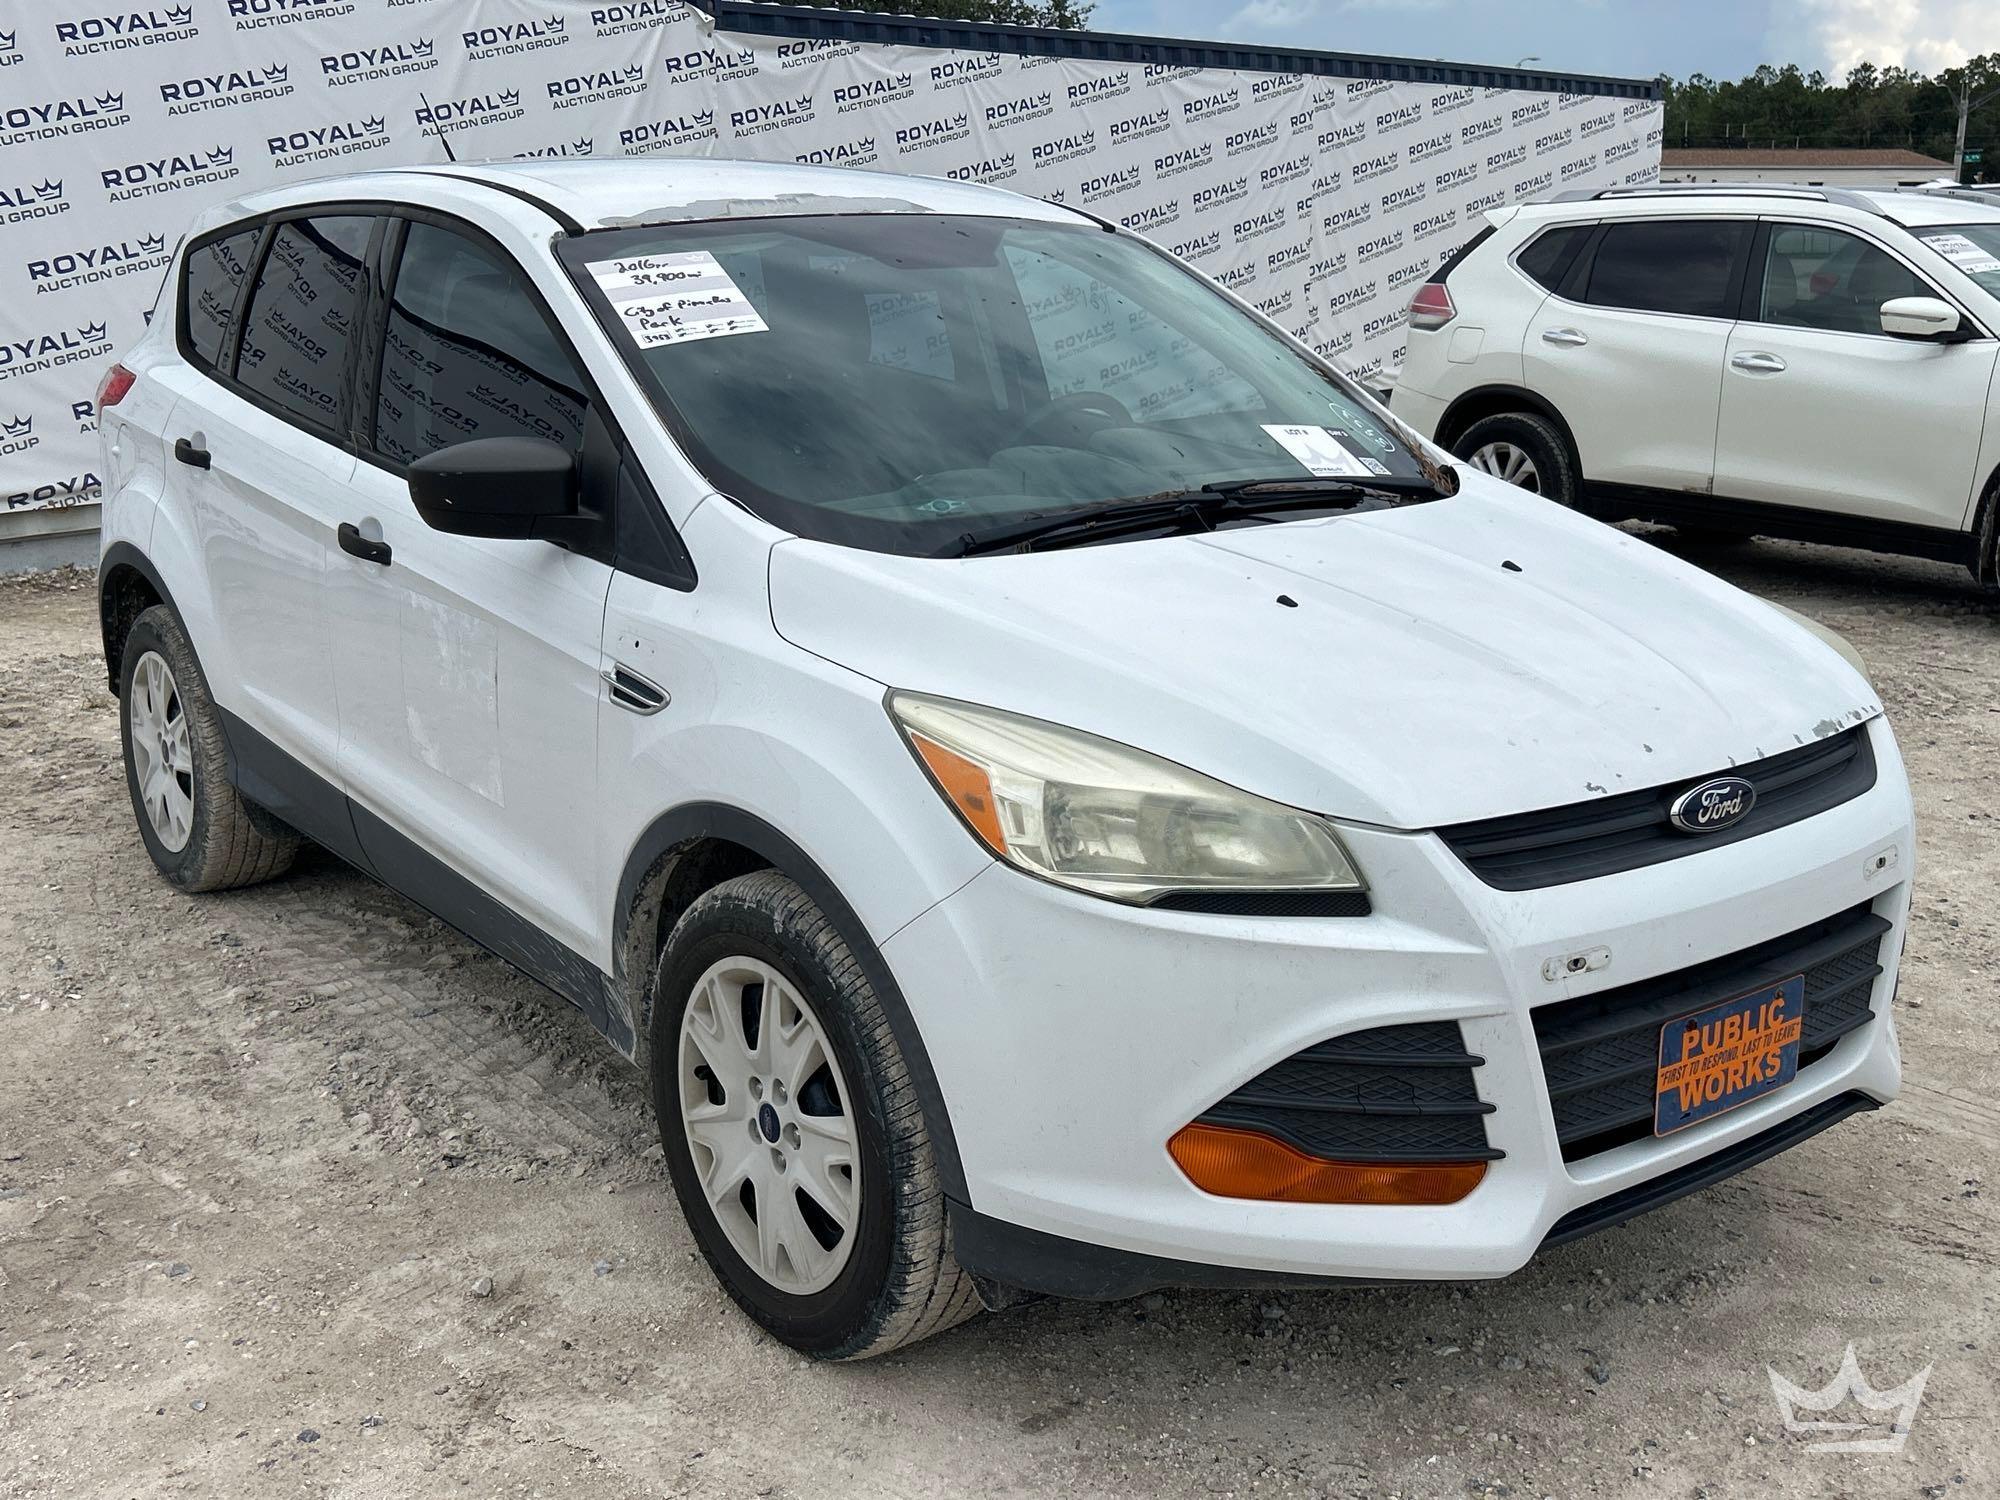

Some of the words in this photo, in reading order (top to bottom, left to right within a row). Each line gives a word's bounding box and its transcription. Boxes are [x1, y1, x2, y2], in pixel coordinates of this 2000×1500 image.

[236, 12, 303, 31] AUCTION
[305, 5, 355, 20] GROUP
[591, 0, 666, 26] ROYAL
[56, 12, 168, 42] ROYAL
[462, 21, 545, 49] ROYAL
[596, 21, 648, 38] AUCTION
[649, 12, 691, 28] GROUP
[65, 37, 140, 57] AUCTION
[143, 28, 199, 45] GROUP
[468, 45, 524, 61] AUCTION
[527, 36, 569, 51] GROUP
[321, 46, 413, 73] ROYAL
[781, 54, 825, 70] AUCTION
[827, 46, 860, 60] GROUP
[931, 58, 986, 81] ROYAL
[328, 68, 390, 87] AUCTION
[392, 59, 439, 75] GROUP
[547, 70, 624, 98] ROYAL
[723, 67, 759, 82] GROUP
[934, 77, 972, 91] AUCTION
[973, 68, 1002, 82] GROUP
[1252, 75, 1292, 94] ROYAL
[160, 70, 265, 102] ROYAL
[552, 92, 605, 110] AUCTION
[607, 83, 648, 100] GROUP
[834, 78, 897, 103] ROYAL
[1068, 76, 1117, 99] ROYAL
[168, 95, 238, 116] AUCTION
[242, 85, 294, 102] GROUP
[415, 95, 500, 125] ROYAL
[837, 97, 880, 114] AUCTION
[881, 90, 914, 104] GROUP
[986, 98, 1038, 121] ROYAL
[1184, 93, 1228, 115] ROYAL
[1432, 91, 1465, 108] ROYAL
[1623, 102, 1649, 117] ROYAL
[421, 118, 479, 138] AUCTION
[480, 109, 524, 125] GROUP
[731, 100, 797, 127] ROYAL
[988, 116, 1024, 131] AUCTION
[1026, 108, 1054, 121] GROUP
[1377, 107, 1412, 127] ROYAL
[1512, 103, 1542, 121] ROYAL
[1581, 115, 1608, 132] ROYAL
[72, 114, 130, 134] GROUP
[620, 117, 694, 146] ROYAL
[734, 121, 779, 139] AUCTION
[781, 113, 815, 128] GROUP
[896, 118, 953, 144] ROYAL
[1110, 114, 1157, 137] ROYAL
[1462, 120, 1494, 138] ROYAL
[268, 123, 363, 155] ROYAL
[673, 128, 717, 145] GROUP
[900, 139, 939, 154] AUCTION
[941, 130, 969, 145] GROUP
[1032, 135, 1083, 160] ROYAL
[1226, 126, 1267, 148] ROYAL
[1318, 126, 1355, 146] ROYAL
[1409, 137, 1442, 156] ROYAL
[1536, 132, 1564, 149] ROYAL
[275, 148, 340, 168] AUCTION
[342, 137, 391, 154] GROUP
[1035, 153, 1069, 170] AUCTION
[1070, 146, 1096, 159] GROUP
[1155, 148, 1200, 171] ROYAL
[1487, 148, 1518, 167] ROYAL
[1605, 141, 1632, 158] ROYAL
[101, 154, 208, 188] ROYAL
[990, 169, 1017, 184] GROUP
[1261, 160, 1299, 182] ROYAL
[1352, 156, 1388, 176] ROYAL
[1436, 168, 1469, 186] ROYAL
[1561, 158, 1589, 175] ROYAL
[1625, 168, 1652, 184] ROYAL
[109, 182, 181, 202] AUCTION
[184, 168, 240, 188] GROUP
[1081, 171, 1128, 195] ROYAL
[1193, 182, 1237, 205] ROYAL
[1515, 176, 1544, 194] ROYAL
[1382, 187, 1416, 206] ROYAL
[1466, 194, 1496, 213] ROYAL
[9, 203, 70, 223] GROUP
[1234, 212, 1274, 236] ROYAL
[1324, 208, 1360, 228] ROYAL
[1414, 214, 1447, 234] ROYAL
[1268, 244, 1306, 266] ROYAL
[1358, 236, 1394, 256] ROYAL
[28, 243, 139, 280] ROYAL
[1388, 262, 1421, 284] ROYAL
[36, 268, 112, 294] AUCTION
[115, 255, 172, 277] GROUP
[657, 302, 673, 313] of
[1331, 286, 1366, 308] ROYAL
[640, 316, 683, 330] Park
[1364, 312, 1398, 334] ROYAL
[0, 359, 50, 380] CTION
[54, 343, 113, 366] GROUP
[0, 437, 40, 456] OUP
[7, 472, 102, 510] ROYA
[1698, 786, 1742, 823] Ford
[1682, 998, 1785, 1064] PUBLIC
[1689, 1061, 1699, 1076] TO
[1742, 1037, 1762, 1056] LAST
[1763, 1034, 1773, 1048] TO
[1679, 1049, 1781, 1112] WORKS
